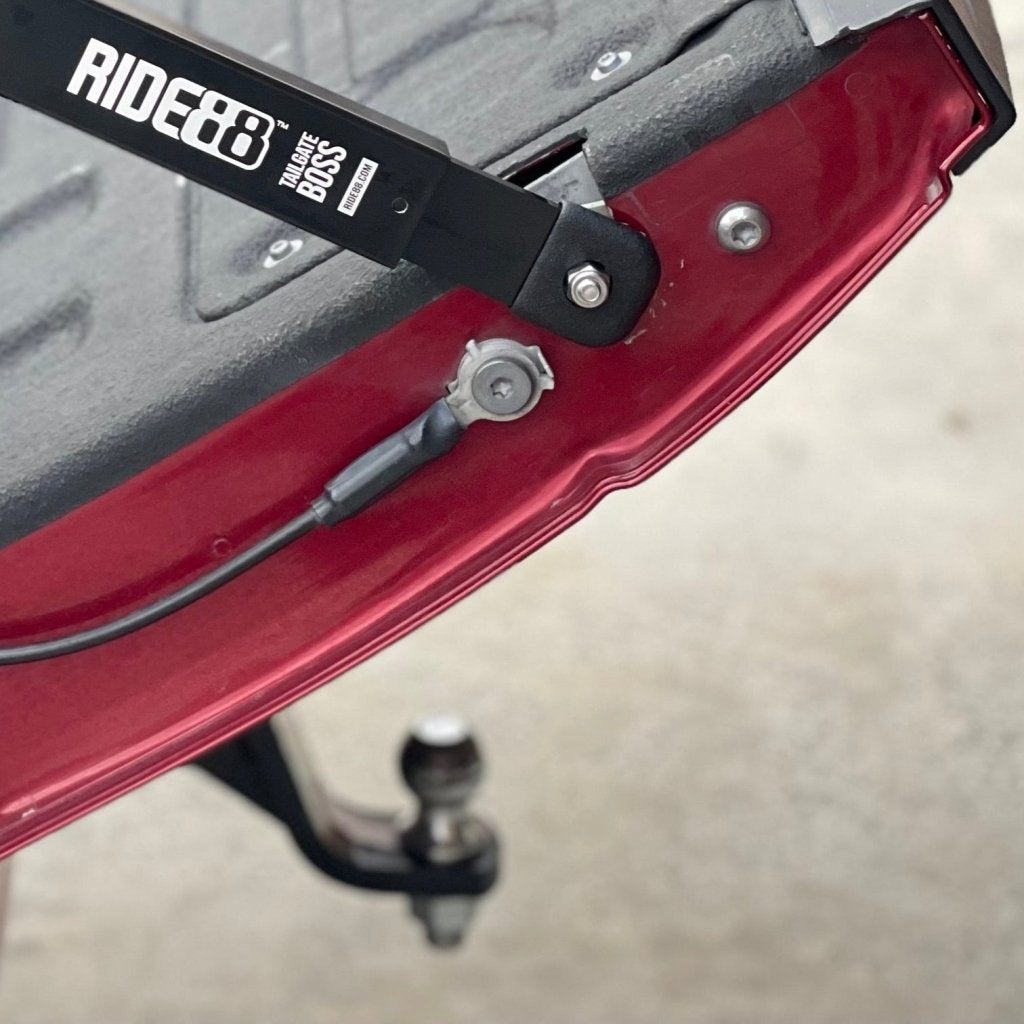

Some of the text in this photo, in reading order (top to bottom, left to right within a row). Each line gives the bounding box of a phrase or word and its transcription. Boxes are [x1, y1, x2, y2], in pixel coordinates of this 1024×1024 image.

[66, 37, 276, 171] RIDE88
[278, 131, 320, 189] TAILGATE
[295, 140, 347, 204] BOSS
[342, 162, 373, 211] RIDE88.COM
